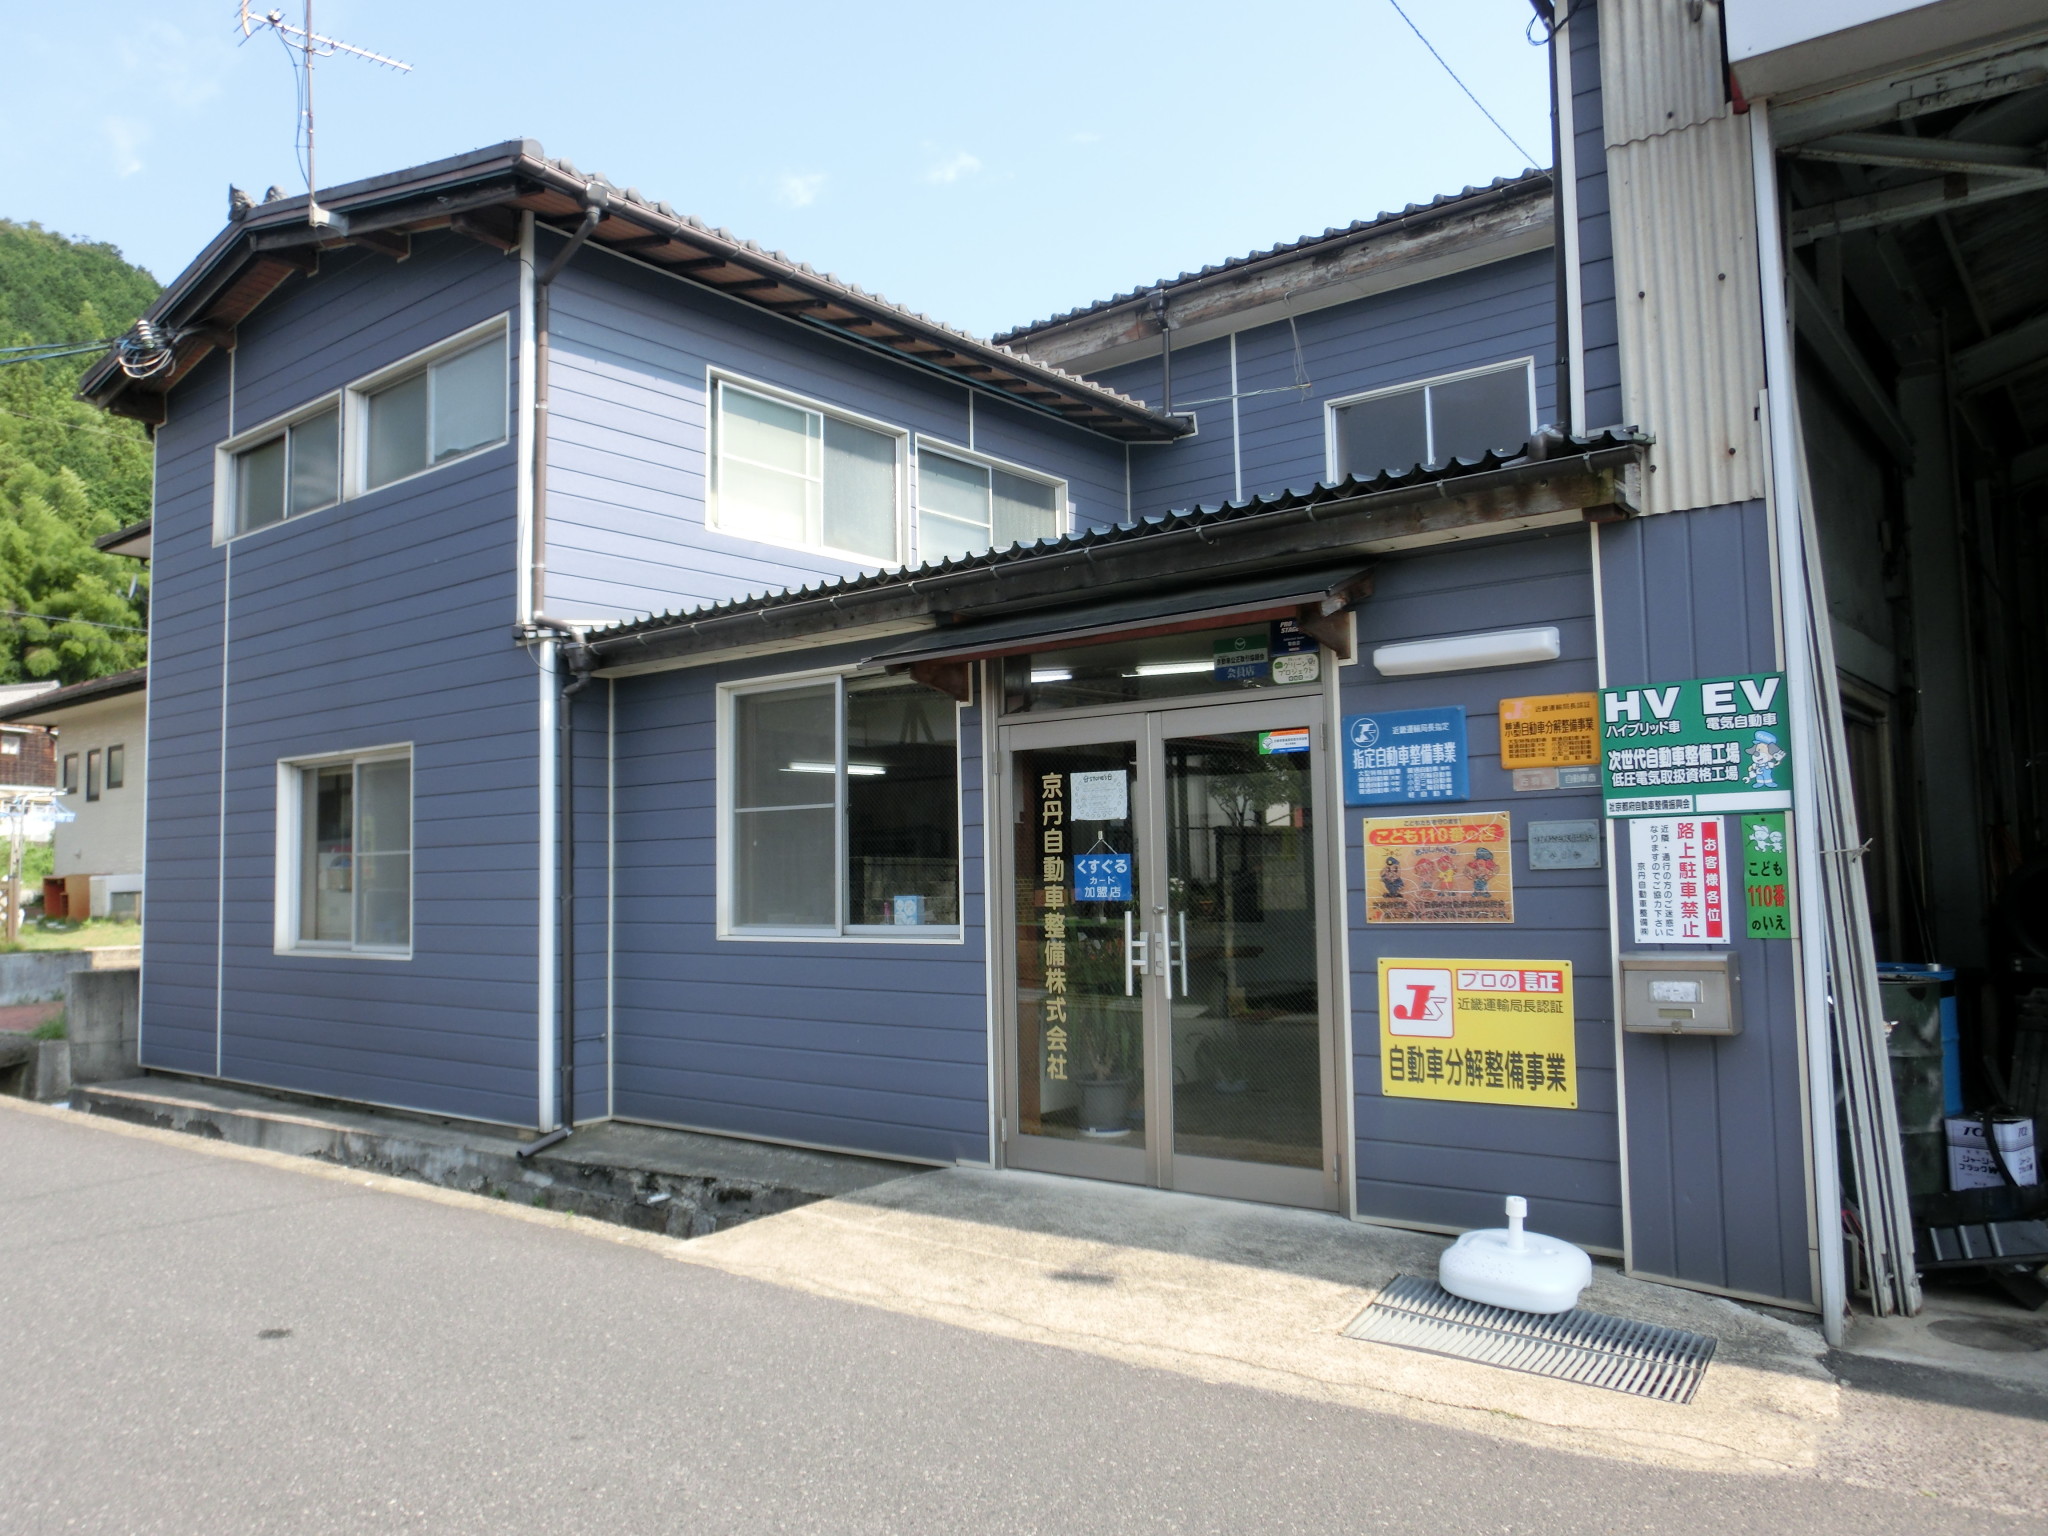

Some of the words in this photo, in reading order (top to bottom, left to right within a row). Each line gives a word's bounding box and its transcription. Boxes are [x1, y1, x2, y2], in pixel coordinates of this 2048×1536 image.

[1604, 686, 1681, 723] HV
[1701, 677, 1781, 716] EV
[1521, 717, 1595, 735] 自動車分解整備事業
[1605, 720, 1681, 739] ハイブリッド車
[1705, 712, 1778, 731] 電気自動車
[1352, 741, 1457, 770] 指定自動車整備事業
[1608, 741, 1741, 772] 次世代自動車整備工場
[1611, 765, 1739, 788] 低圧電気取扱資格工場
[1077, 859, 1128, 874] くすぐる
[1677, 822, 1700, 938] 路上駐車禁止
[1748, 861, 1783, 877] こども
[1084, 886, 1121, 898] 加盟店
[1089, 876, 1116, 885] カード
[1650, 825, 1664, 937] なりますのでご協力下さい
[1660, 824, 1674, 937] 近隣・通行の方のご迷惑に
[1703, 838, 1721, 923] お客様各位
[1748, 883, 1786, 908] 110番
[1041, 771, 1068, 1081] 京丹自動車整備株式会社
[1751, 914, 1786, 931] のいえ
[1457, 997, 1565, 1014] 近畿運輸局長認証
[1389, 1044, 1568, 1093] 自動車分解整備事業
